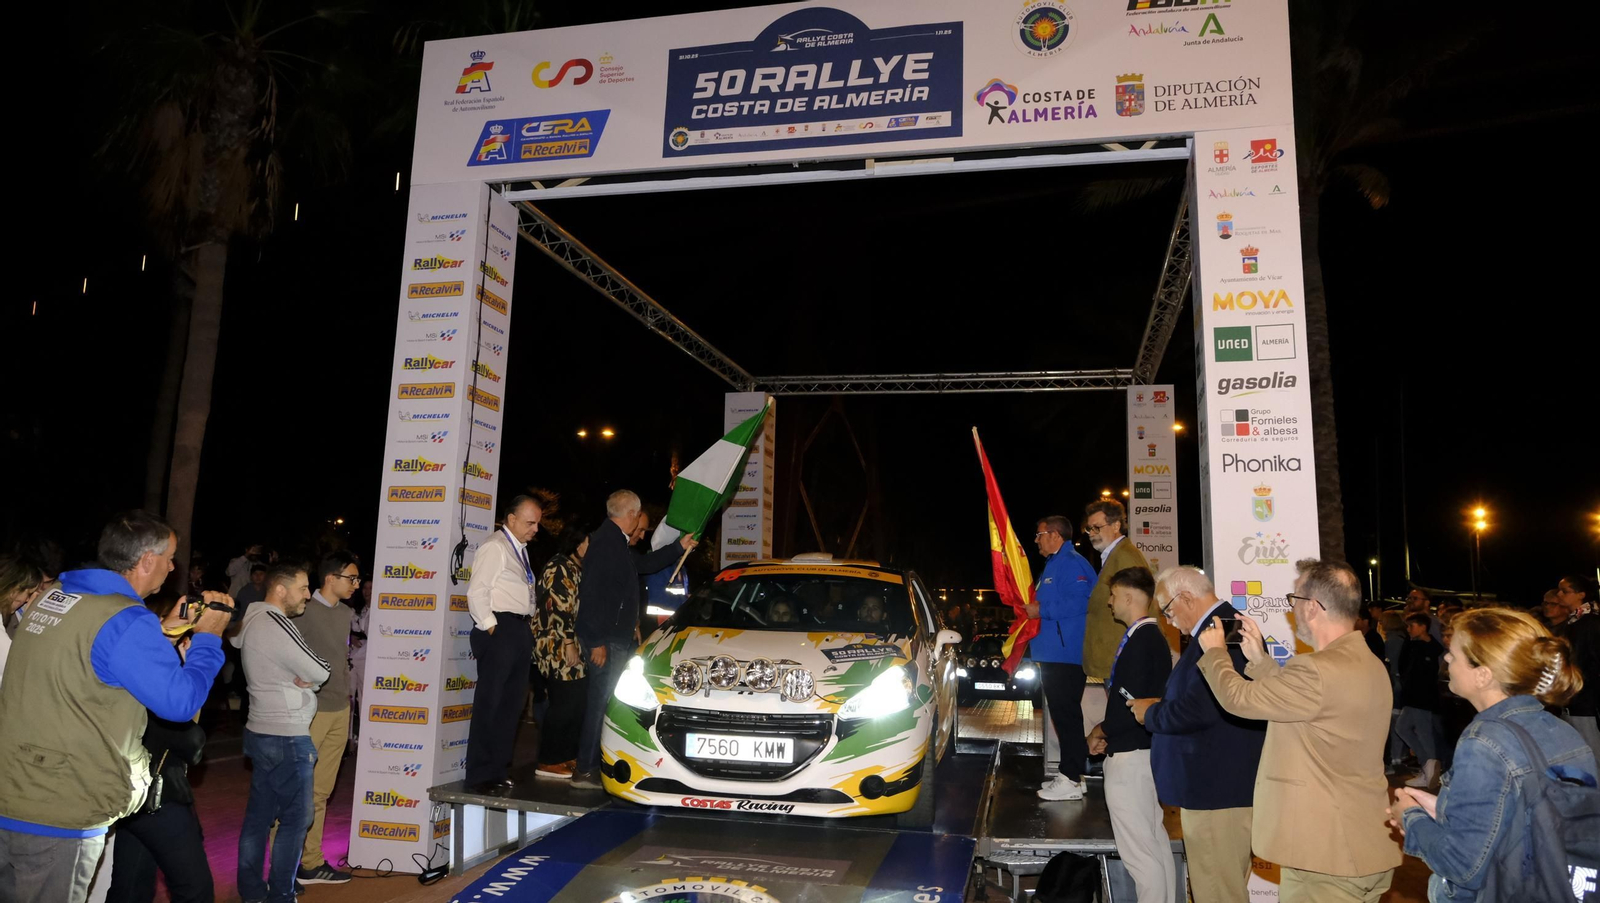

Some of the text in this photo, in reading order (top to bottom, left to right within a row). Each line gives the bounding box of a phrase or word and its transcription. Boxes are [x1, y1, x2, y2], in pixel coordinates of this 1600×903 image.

[1016, 2, 1074, 25] AUTOMOVIL CLUB
[796, 34, 826, 43] RALLYE
[1211, 36, 1244, 44] Andalucía
[692, 52, 934, 99] 50 RALLYE
[1154, 75, 1261, 98] DIPUTACIÓN
[691, 84, 930, 119] COSTA DE ALMERÍA
[1023, 89, 1096, 104] COSTA DE
[1154, 91, 1257, 112] DE ALMERÍA
[1008, 100, 1097, 124] ALMERÍA
[521, 117, 592, 137] CERA
[533, 142, 577, 156] Recalvi
[1208, 165, 1236, 173] ALMERÍA
[491, 223, 511, 241] MICHELIN
[414, 258, 464, 270] Rallycar
[419, 285, 453, 295] Recalvi
[1213, 289, 1294, 311] MOYA
[483, 320, 504, 334] MICHELIN
[1218, 339, 1248, 349] UNED
[404, 358, 455, 370] Rallycar
[1217, 371, 1297, 395] gasolia
[409, 386, 444, 396] Recalvi
[474, 419, 496, 430] MICHELIN
[1251, 416, 1298, 425] Fornieles
[1252, 427, 1298, 436] & albesa
[394, 459, 446, 472] Rallycar
[1134, 464, 1171, 474] MOYA
[1222, 453, 1301, 473] Phonika
[399, 489, 434, 499] Recalvi
[1135, 505, 1172, 514] gasolia
[466, 522, 488, 531] MICHELIN
[1136, 542, 1172, 552] Phonika
[1238, 537, 1290, 566] Enix
[384, 565, 437, 579] Rallycar
[390, 596, 425, 607] Recalvi
[28, 611, 62, 626] FOTO/TV
[26, 622, 45, 634] 2025
[375, 676, 429, 692] Rallycar
[380, 708, 417, 720] Recalvi
[697, 738, 786, 760] 7560 KMW
[365, 791, 420, 808] Rallycar
[681, 797, 795, 814] COSTAS Racing
[371, 825, 408, 837] Recalvi
